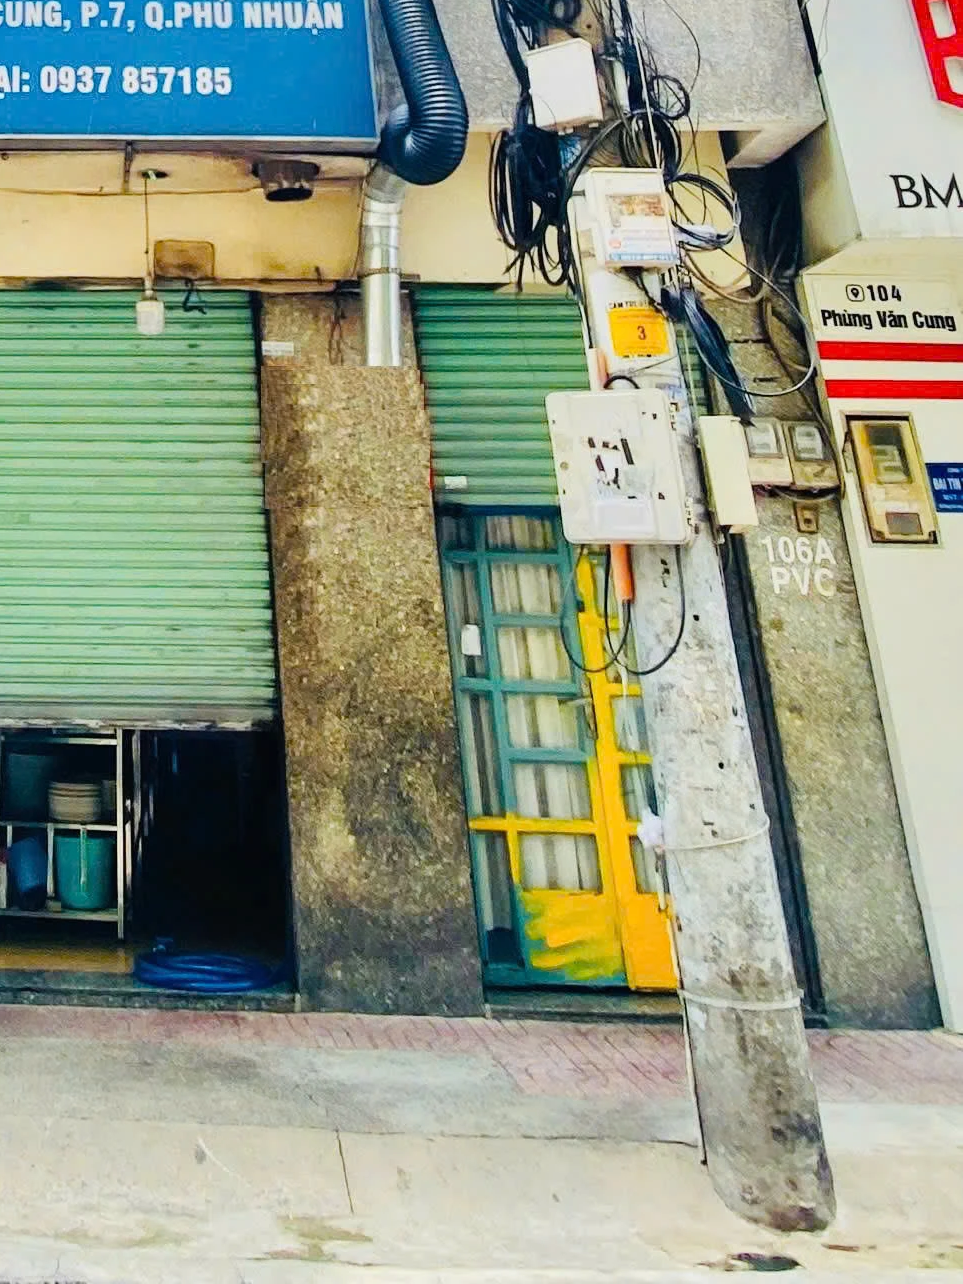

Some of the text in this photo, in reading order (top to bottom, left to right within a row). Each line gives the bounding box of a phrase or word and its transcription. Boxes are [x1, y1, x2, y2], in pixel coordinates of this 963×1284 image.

[80, 1, 135, 33] P.7,
[40, 66, 112, 93] 0937
[122, 66, 232, 95] 857185
[866, 284, 902, 302] 104
[637, 325, 648, 341] 3
[820, 309, 957, 332] Phùng Văn Cung
[760, 535, 837, 565] 106A
[770, 566, 835, 597] PVC
